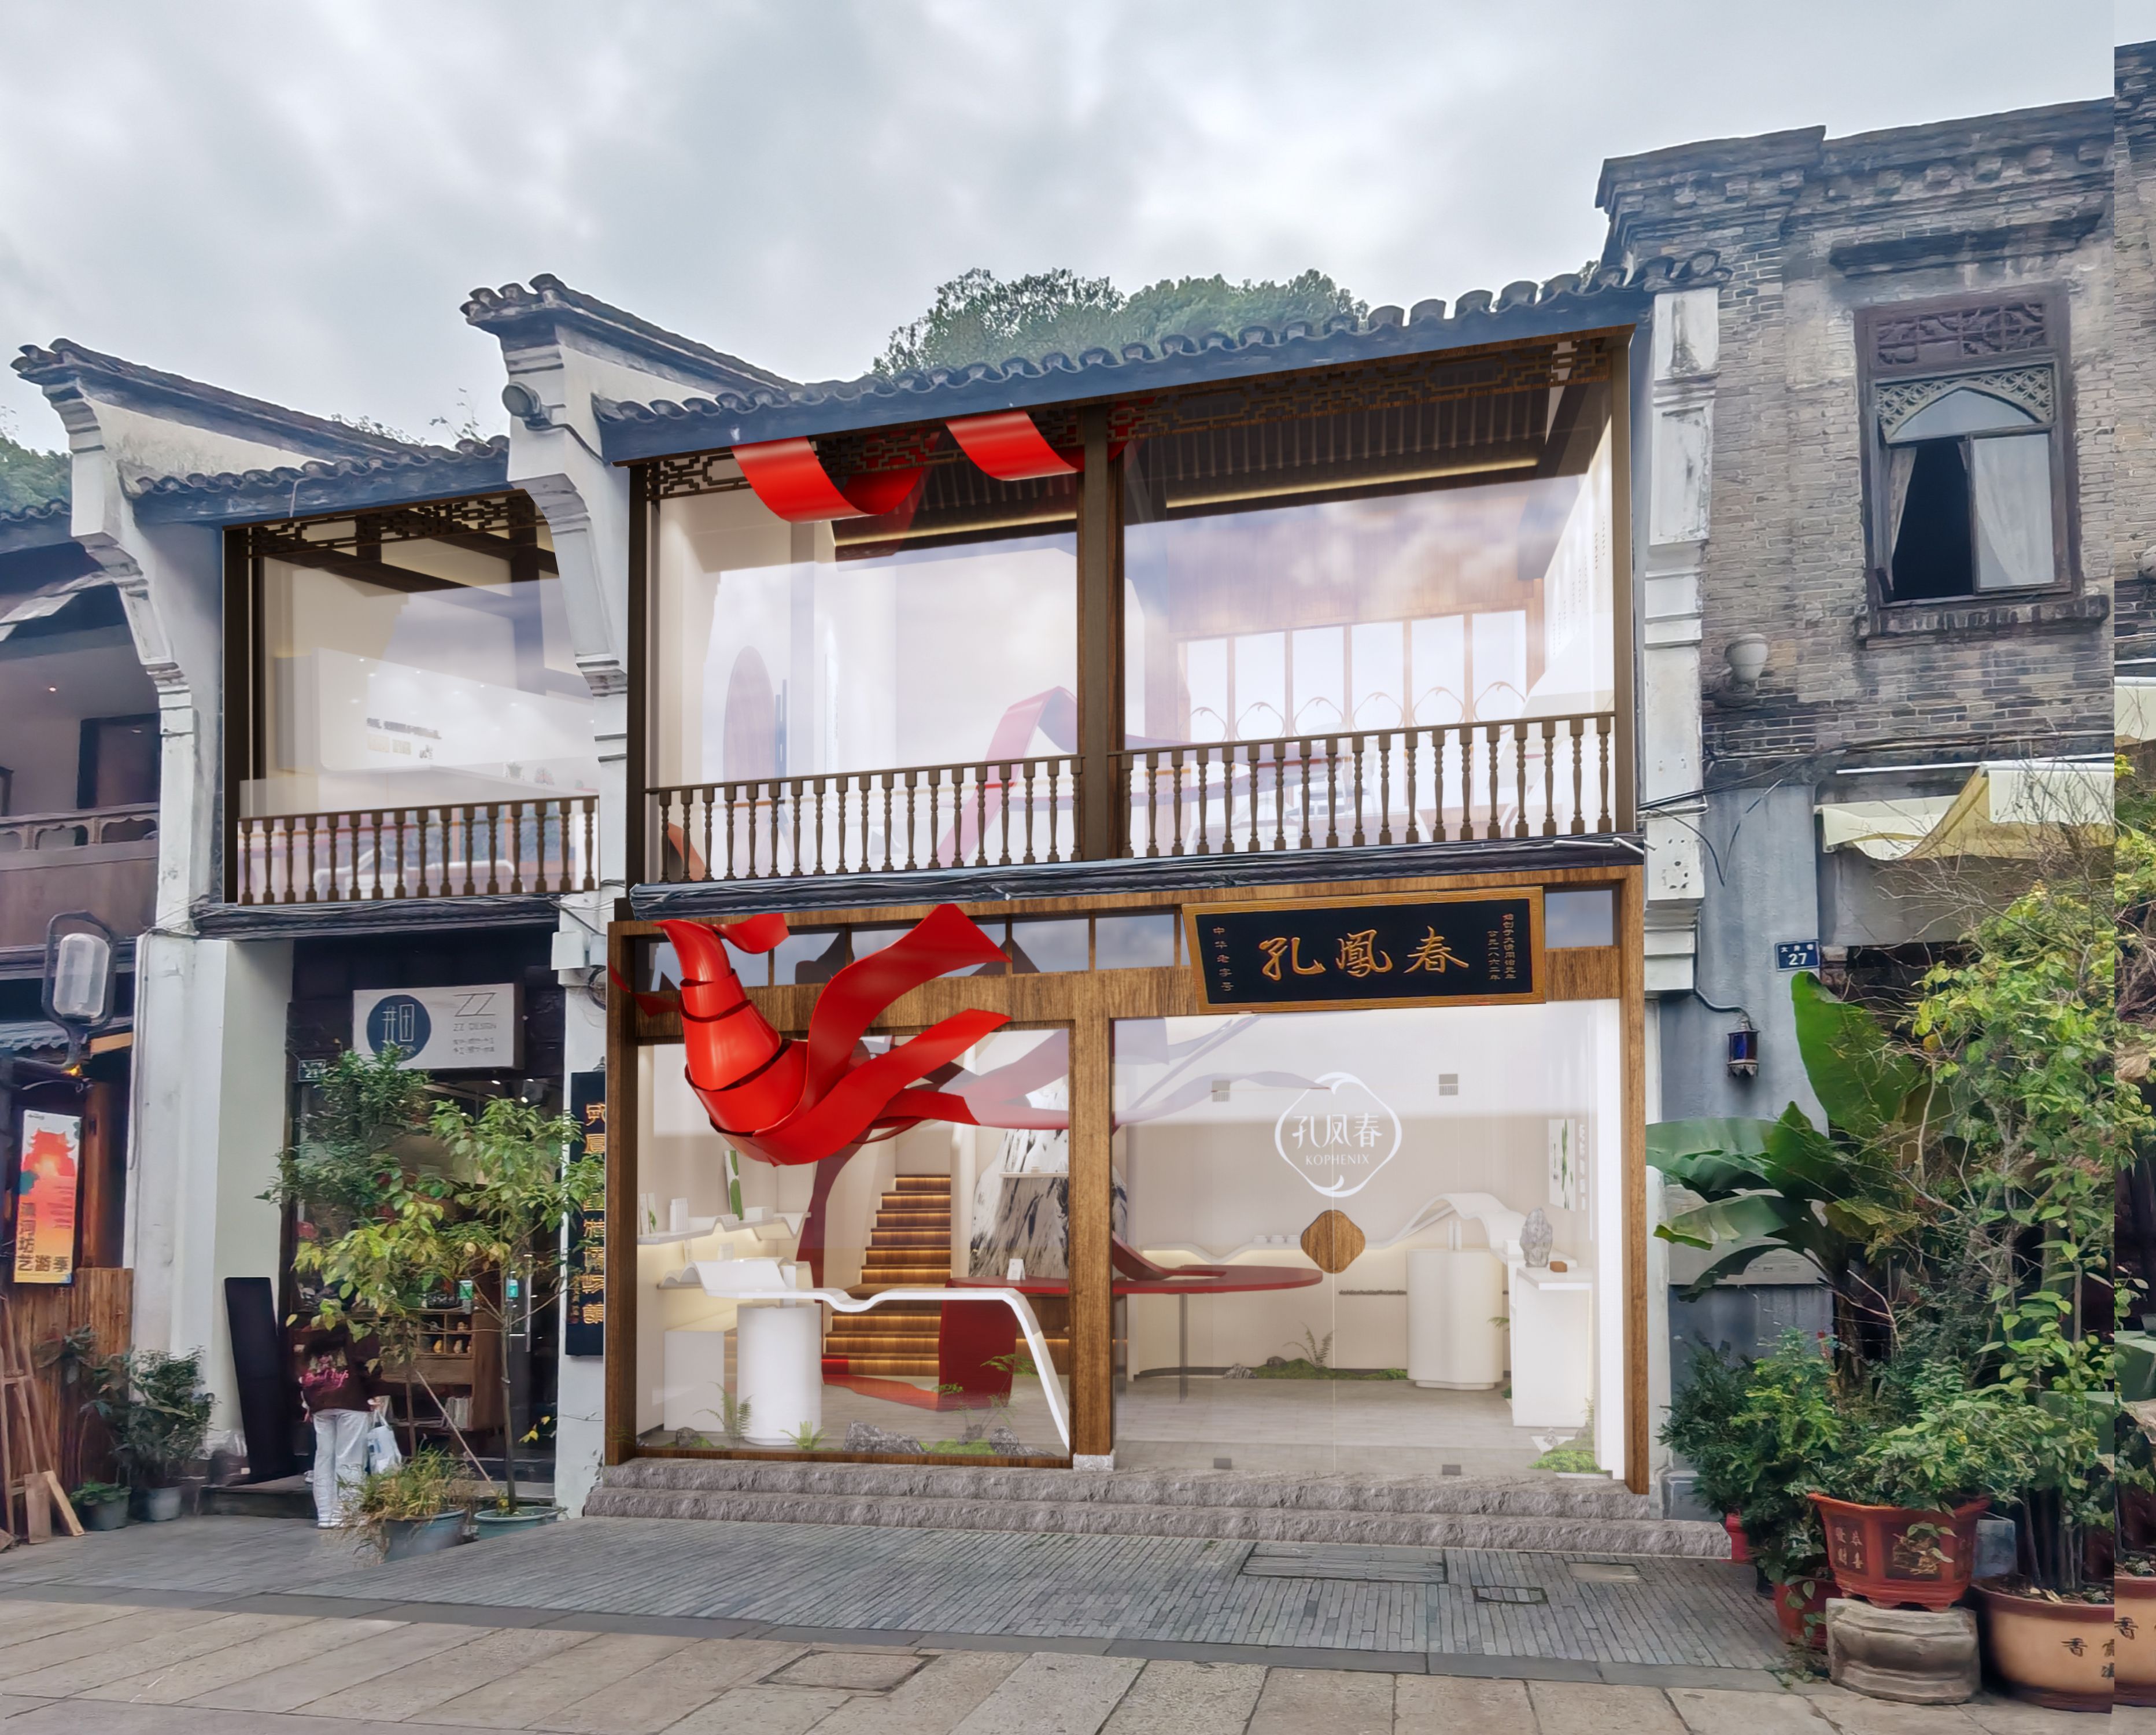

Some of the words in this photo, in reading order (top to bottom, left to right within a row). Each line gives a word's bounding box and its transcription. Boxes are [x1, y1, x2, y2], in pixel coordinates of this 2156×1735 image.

[1258, 925, 1470, 981] 孔鳳春
[1788, 952, 1807, 966] 27
[1291, 1112, 1383, 1149] 孔凤春
[1305, 1154, 1369, 1166] KOPHENIX
